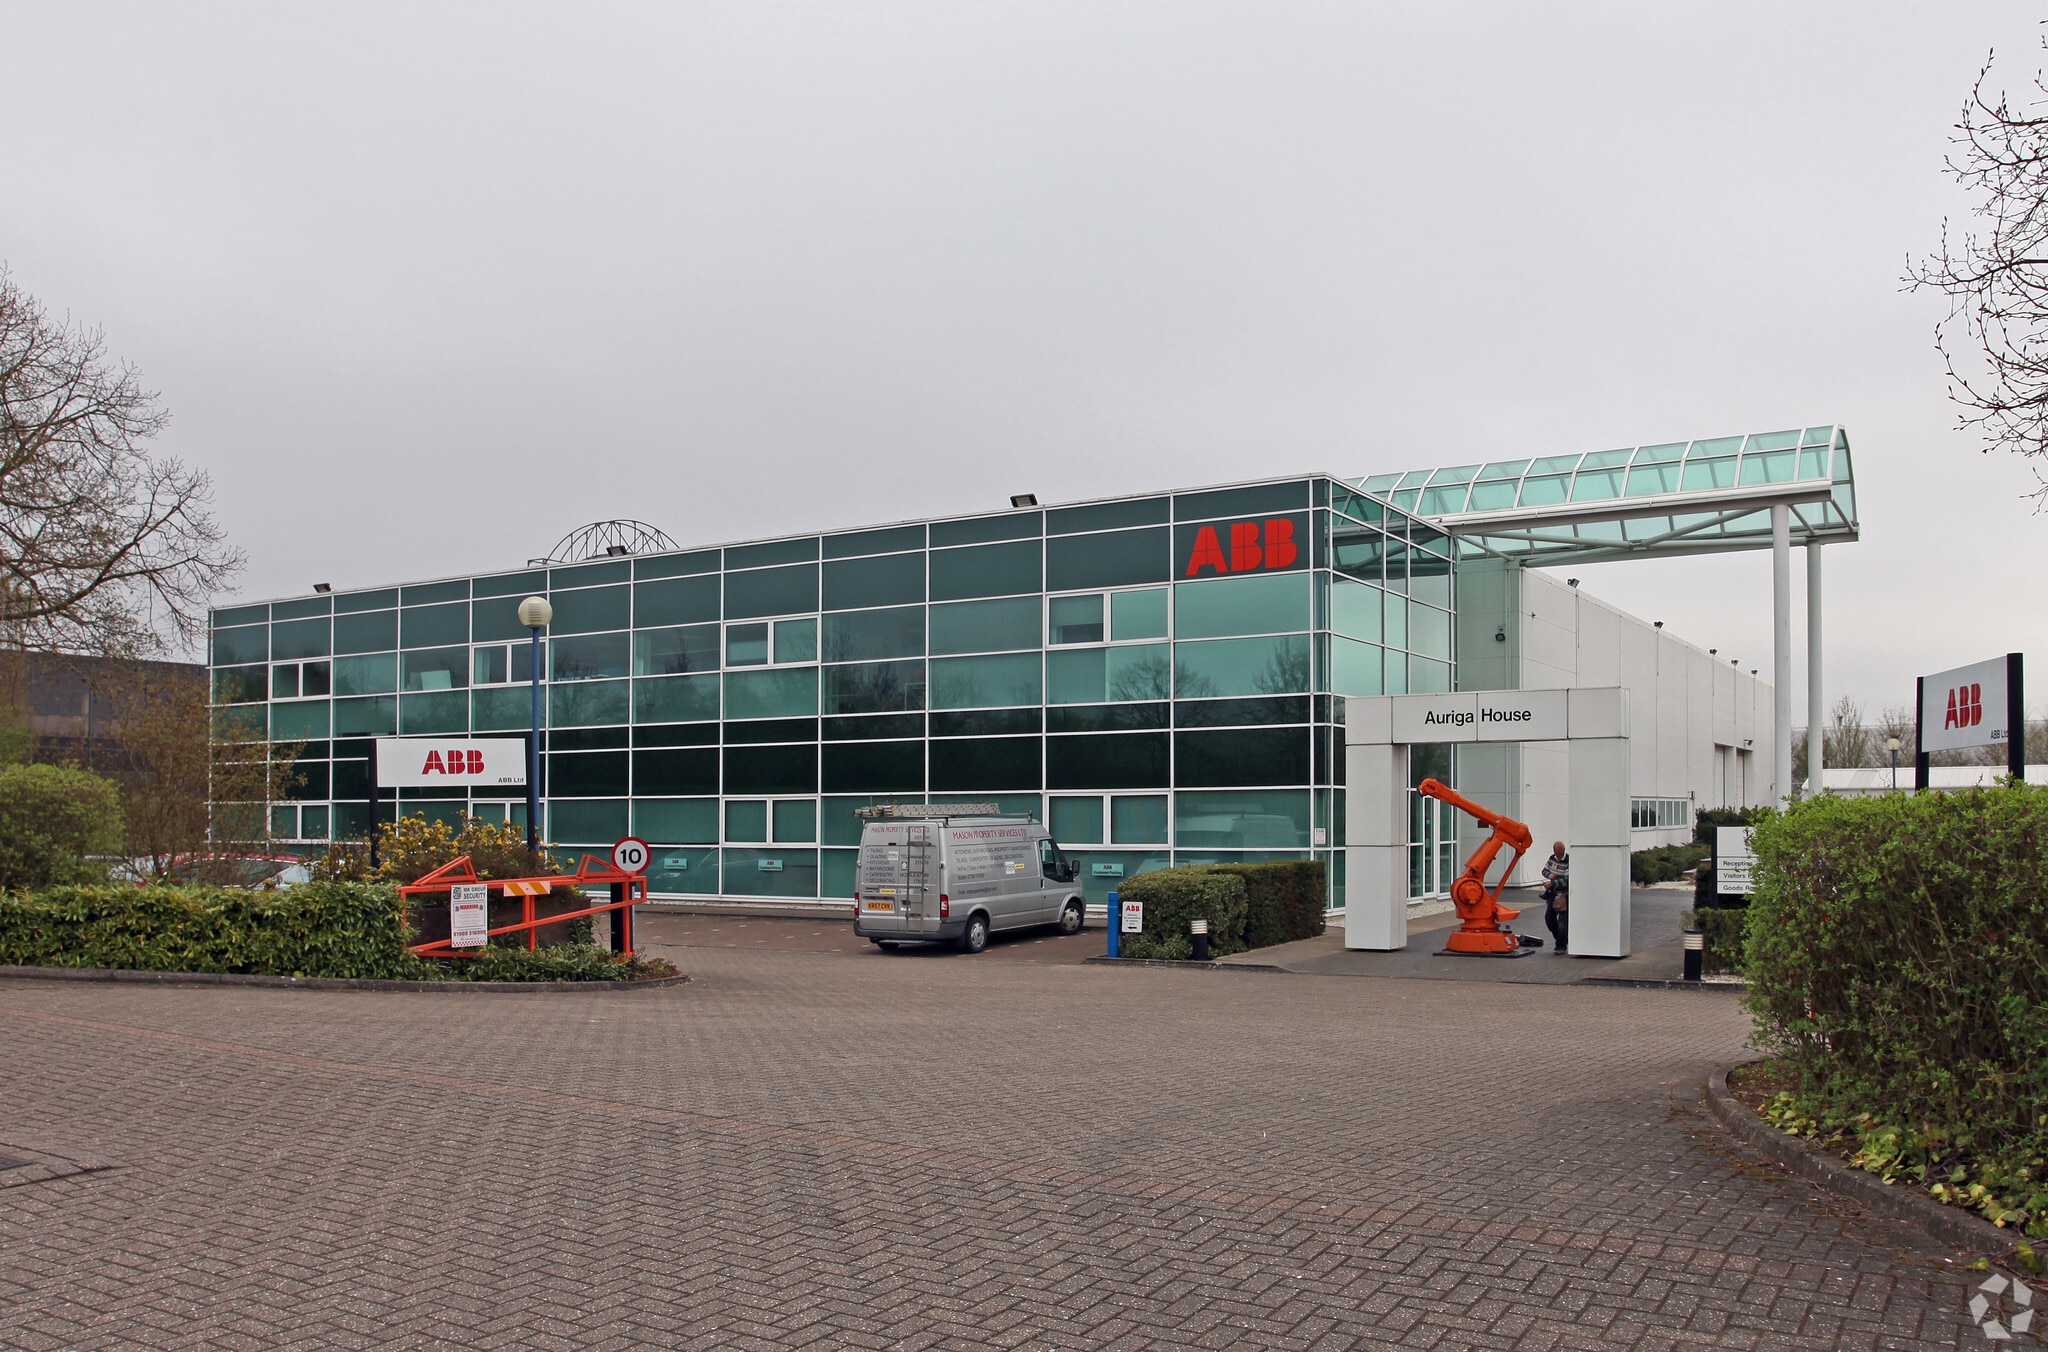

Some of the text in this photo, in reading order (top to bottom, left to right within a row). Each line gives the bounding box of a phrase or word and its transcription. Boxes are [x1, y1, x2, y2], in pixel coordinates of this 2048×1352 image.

[1186, 518, 1298, 576] ABB
[1945, 683, 1982, 730] ABB
[1425, 708, 1531, 726] Auriga House
[1991, 730, 2000, 739] ABB
[422, 750, 485, 774] ABB
[952, 828, 1027, 839] MASON PROPERTY SERVICES LTD
[620, 848, 642, 864] 10
